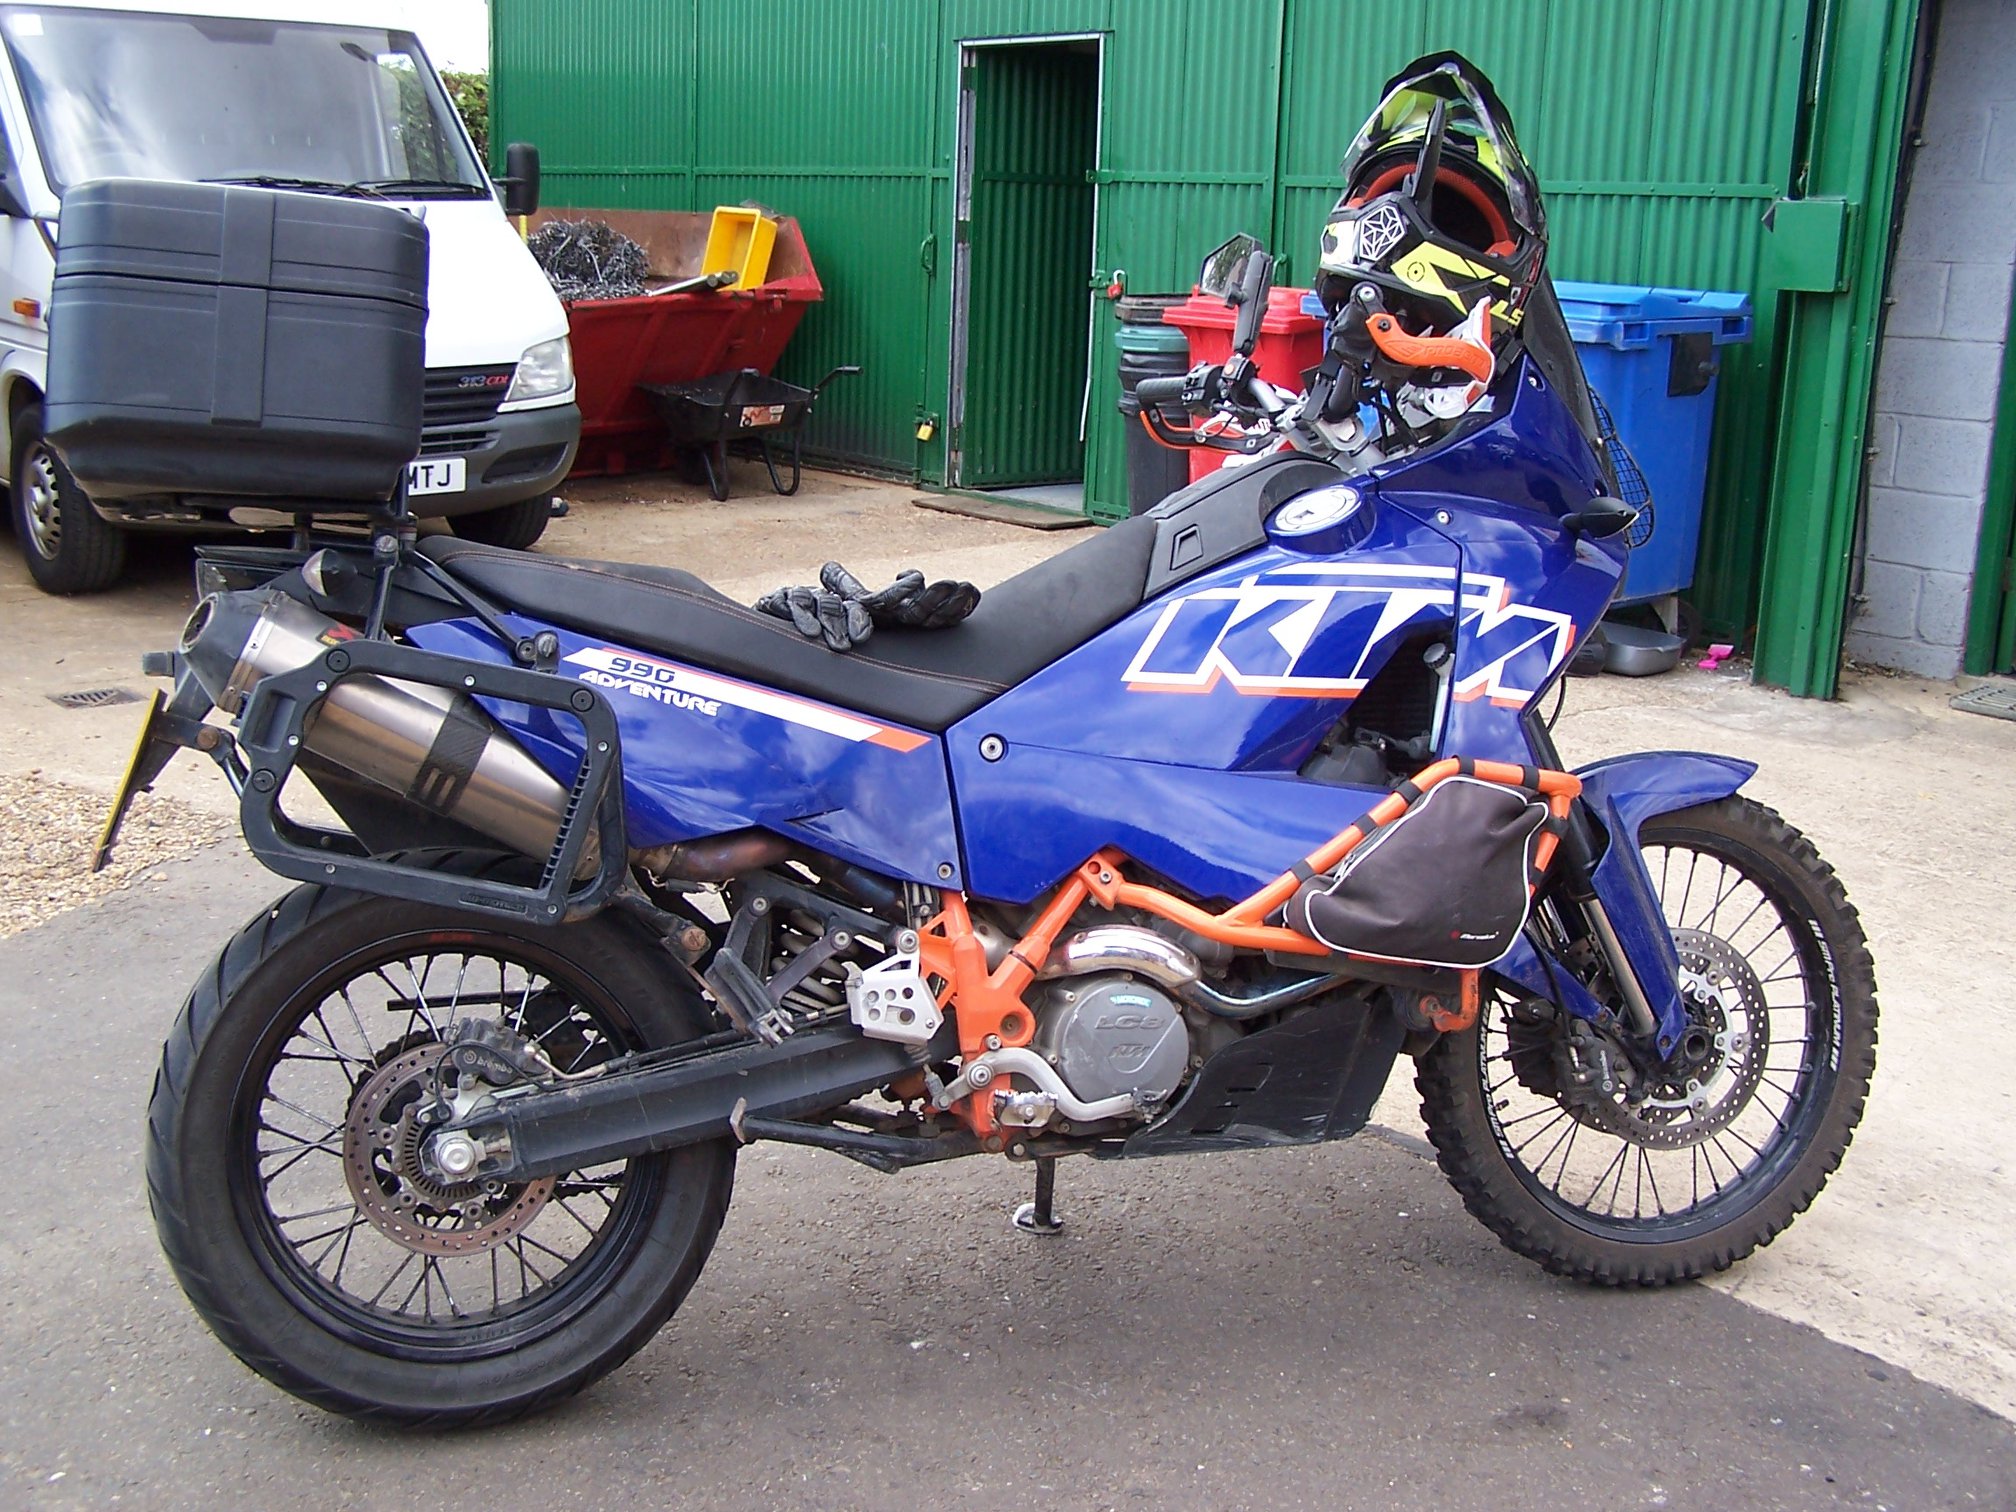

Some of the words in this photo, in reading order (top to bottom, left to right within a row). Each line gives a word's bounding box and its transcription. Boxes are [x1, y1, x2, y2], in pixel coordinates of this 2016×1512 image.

[409, 463, 450, 489] MTJ
[1120, 562, 1576, 709] KTM
[608, 657, 675, 683] 990
[579, 670, 722, 717] ADVENTURE
[1094, 1015, 1165, 1030] LC8
[1830, 984, 1842, 1048] PLATINUM
